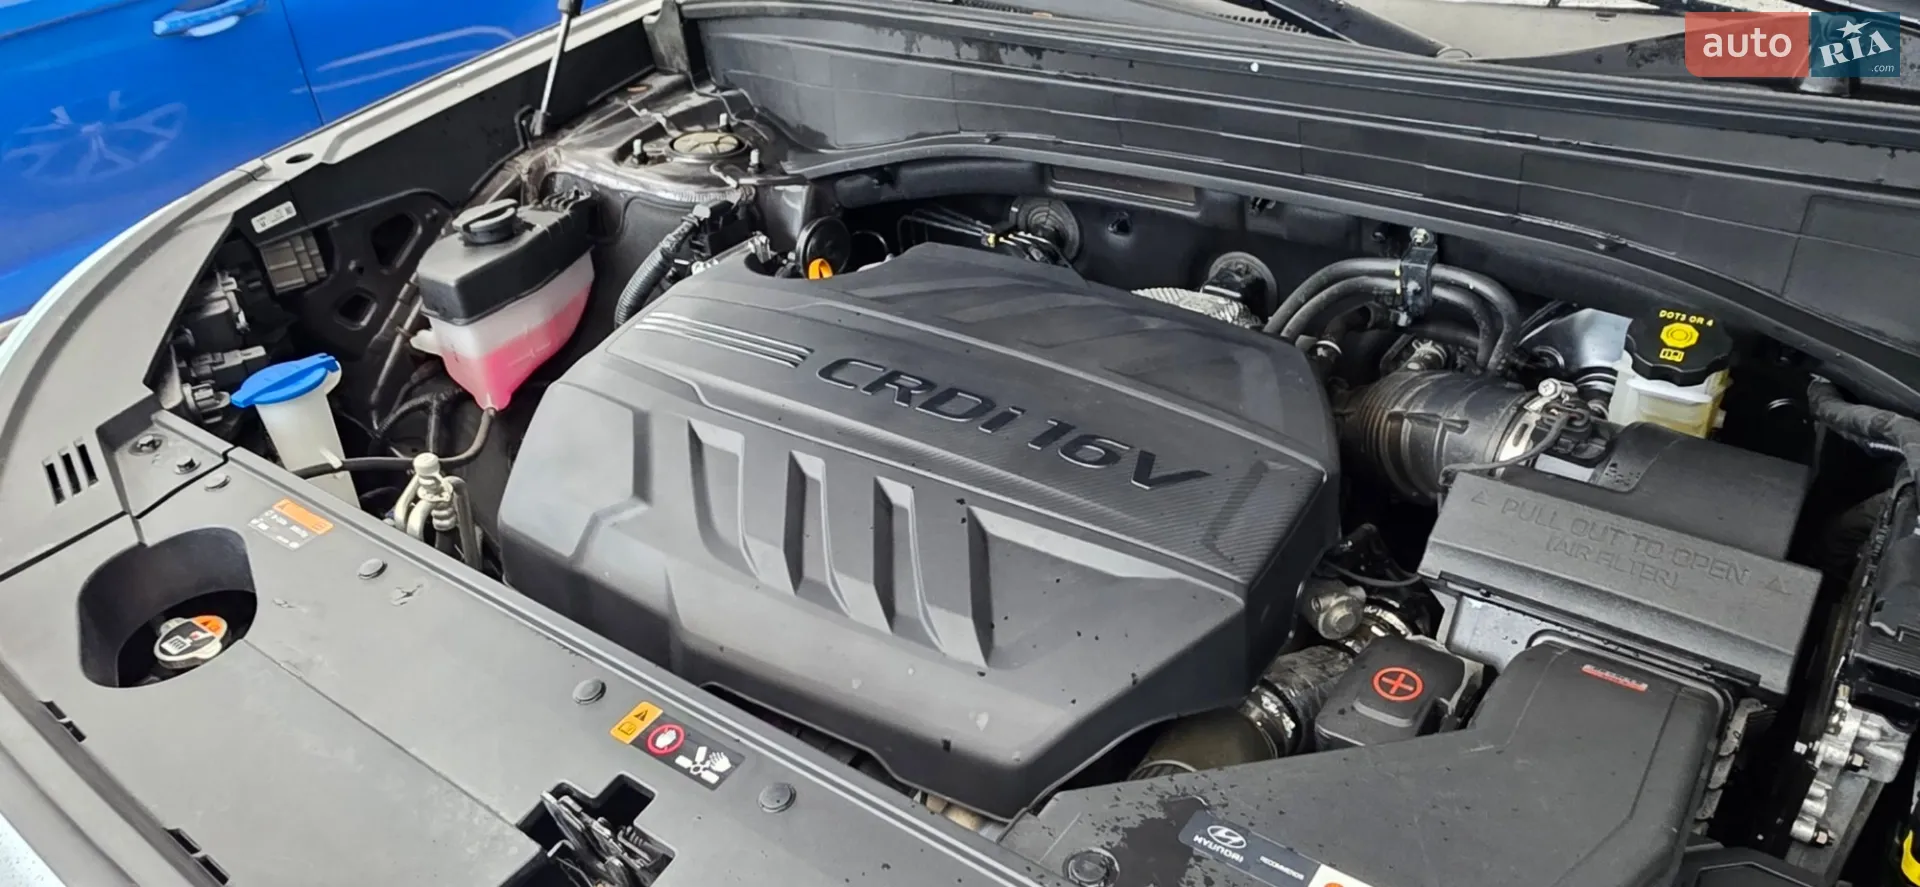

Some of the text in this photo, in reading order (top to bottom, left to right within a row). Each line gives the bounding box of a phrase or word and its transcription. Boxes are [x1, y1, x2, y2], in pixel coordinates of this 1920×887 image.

[1659, 309, 1714, 327] DOT3 OR 4
[1027, 417, 1212, 490] 16V
[1501, 497, 1749, 585] PULL OUT TO OPEN
[1193, 834, 1244, 863] HYUNDAI
